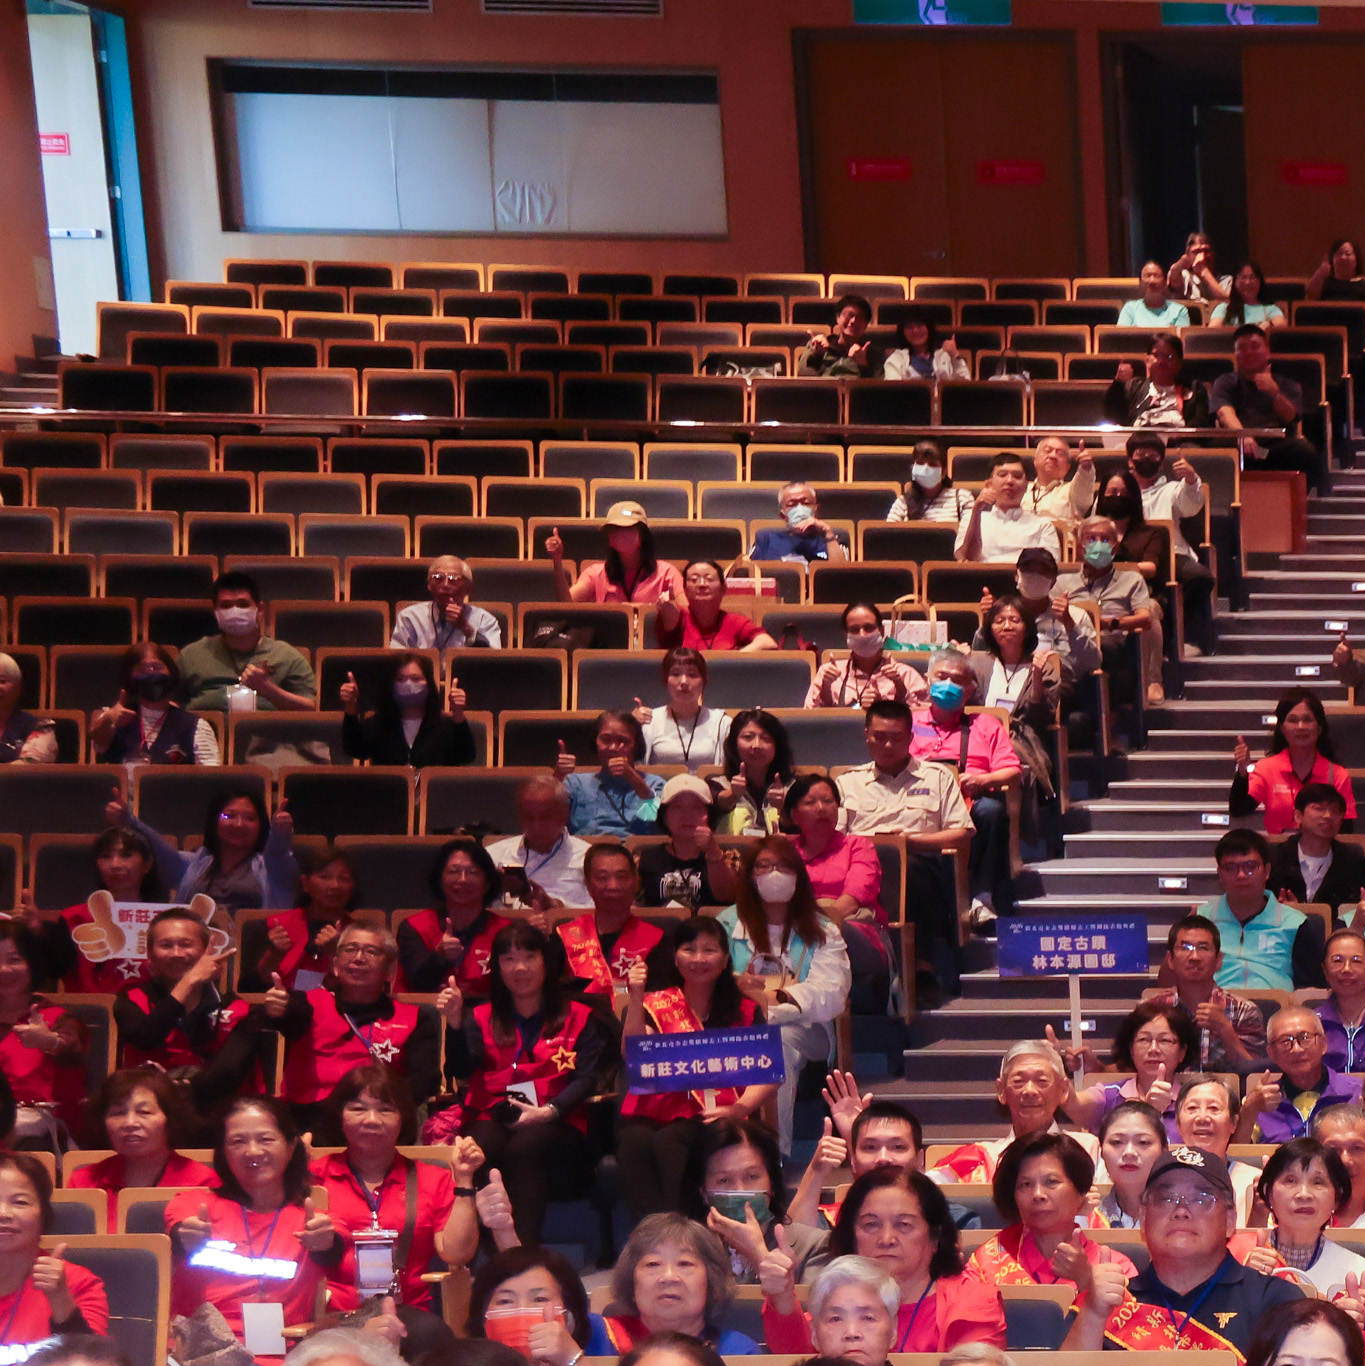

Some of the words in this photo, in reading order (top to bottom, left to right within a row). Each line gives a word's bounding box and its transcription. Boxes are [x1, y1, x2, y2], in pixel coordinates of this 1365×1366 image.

[1040, 935, 1107, 951] 國定古蹟
[1032, 953, 1116, 970] 林本源園邸
[640, 1054, 773, 1079] 新莊文化藝術中心
[1111, 1302, 1141, 1330] 202
